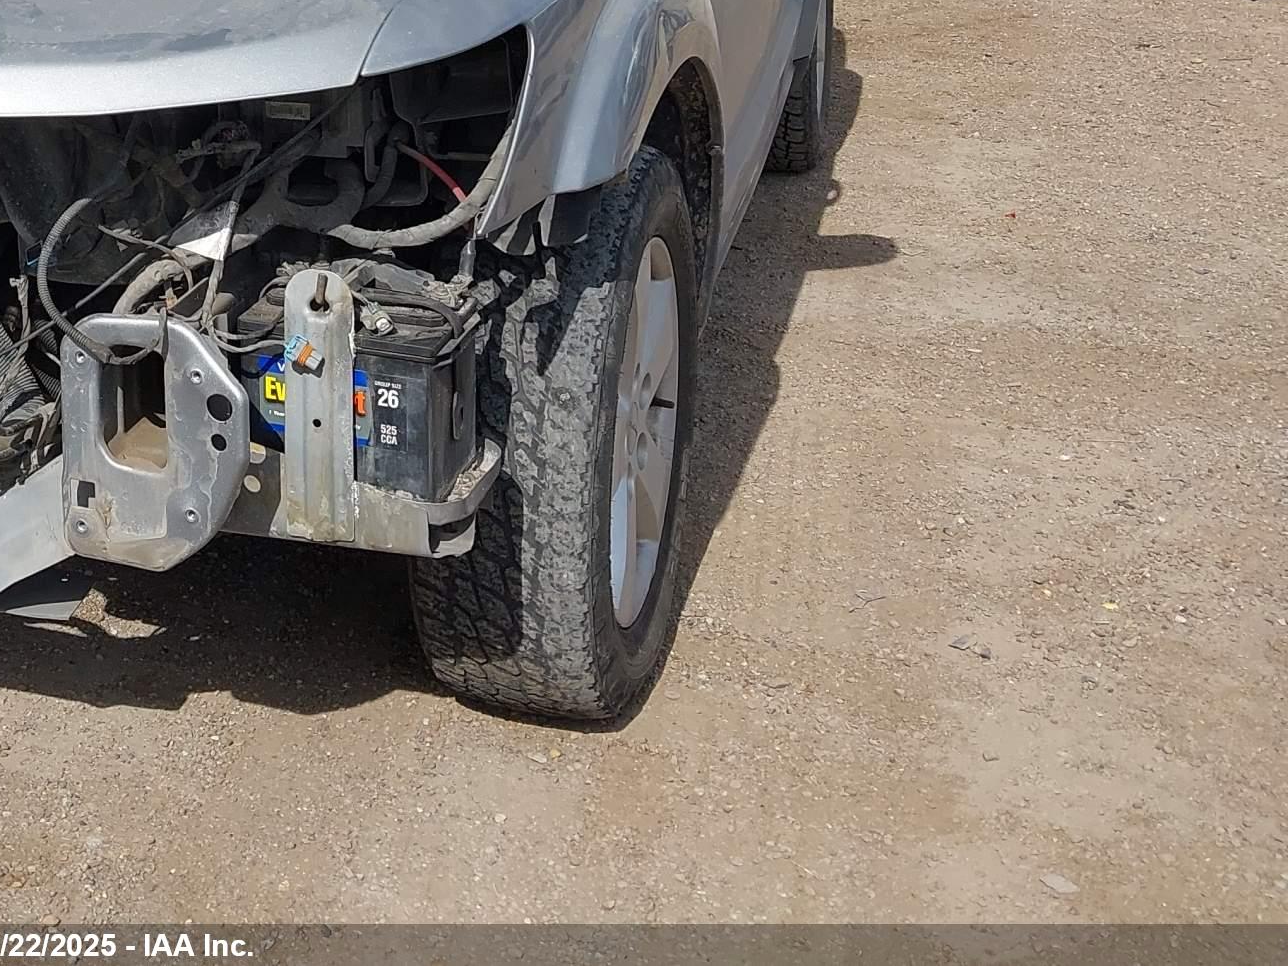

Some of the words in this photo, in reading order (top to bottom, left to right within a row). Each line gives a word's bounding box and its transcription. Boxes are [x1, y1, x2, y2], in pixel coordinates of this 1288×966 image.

[377, 388, 399, 409] 26
[380, 423, 398, 435] 525
[380, 434, 398, 446] CCA
